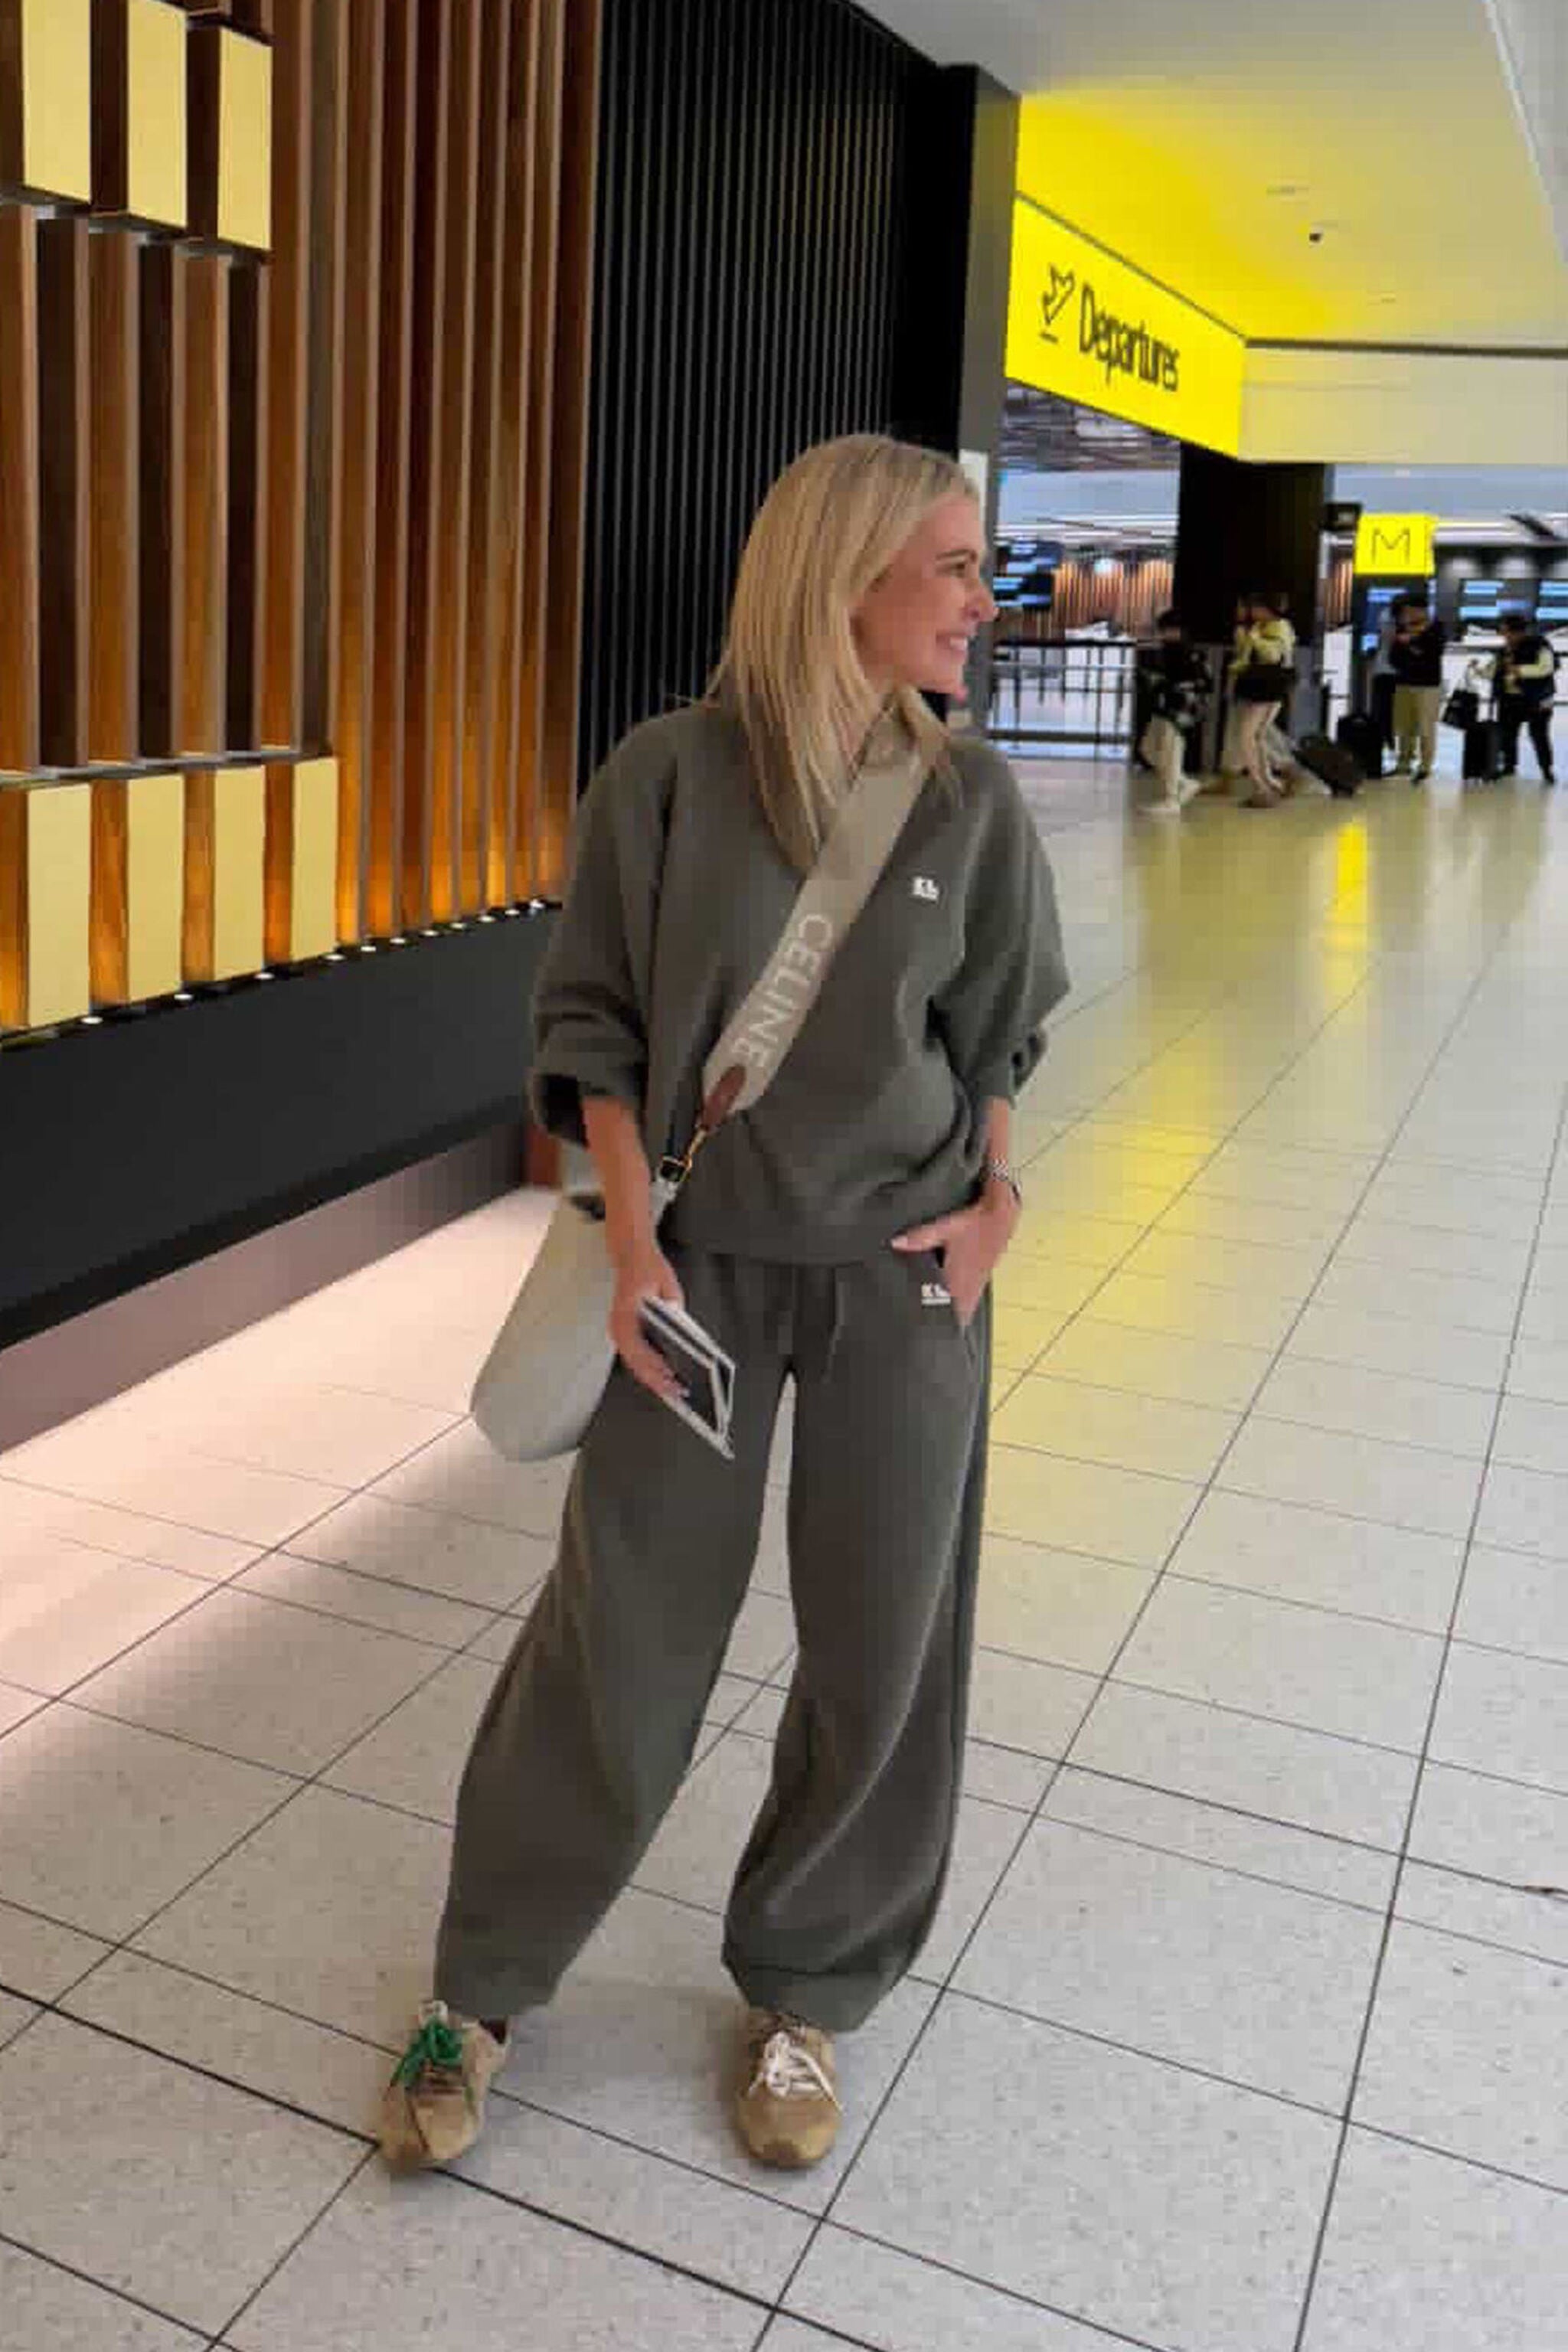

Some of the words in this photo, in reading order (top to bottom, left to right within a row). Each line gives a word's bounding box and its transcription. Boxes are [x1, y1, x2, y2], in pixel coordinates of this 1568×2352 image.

[1080, 283, 1180, 391] Departures
[1371, 528, 1410, 564] M
[733, 915, 832, 1067] CELINE
